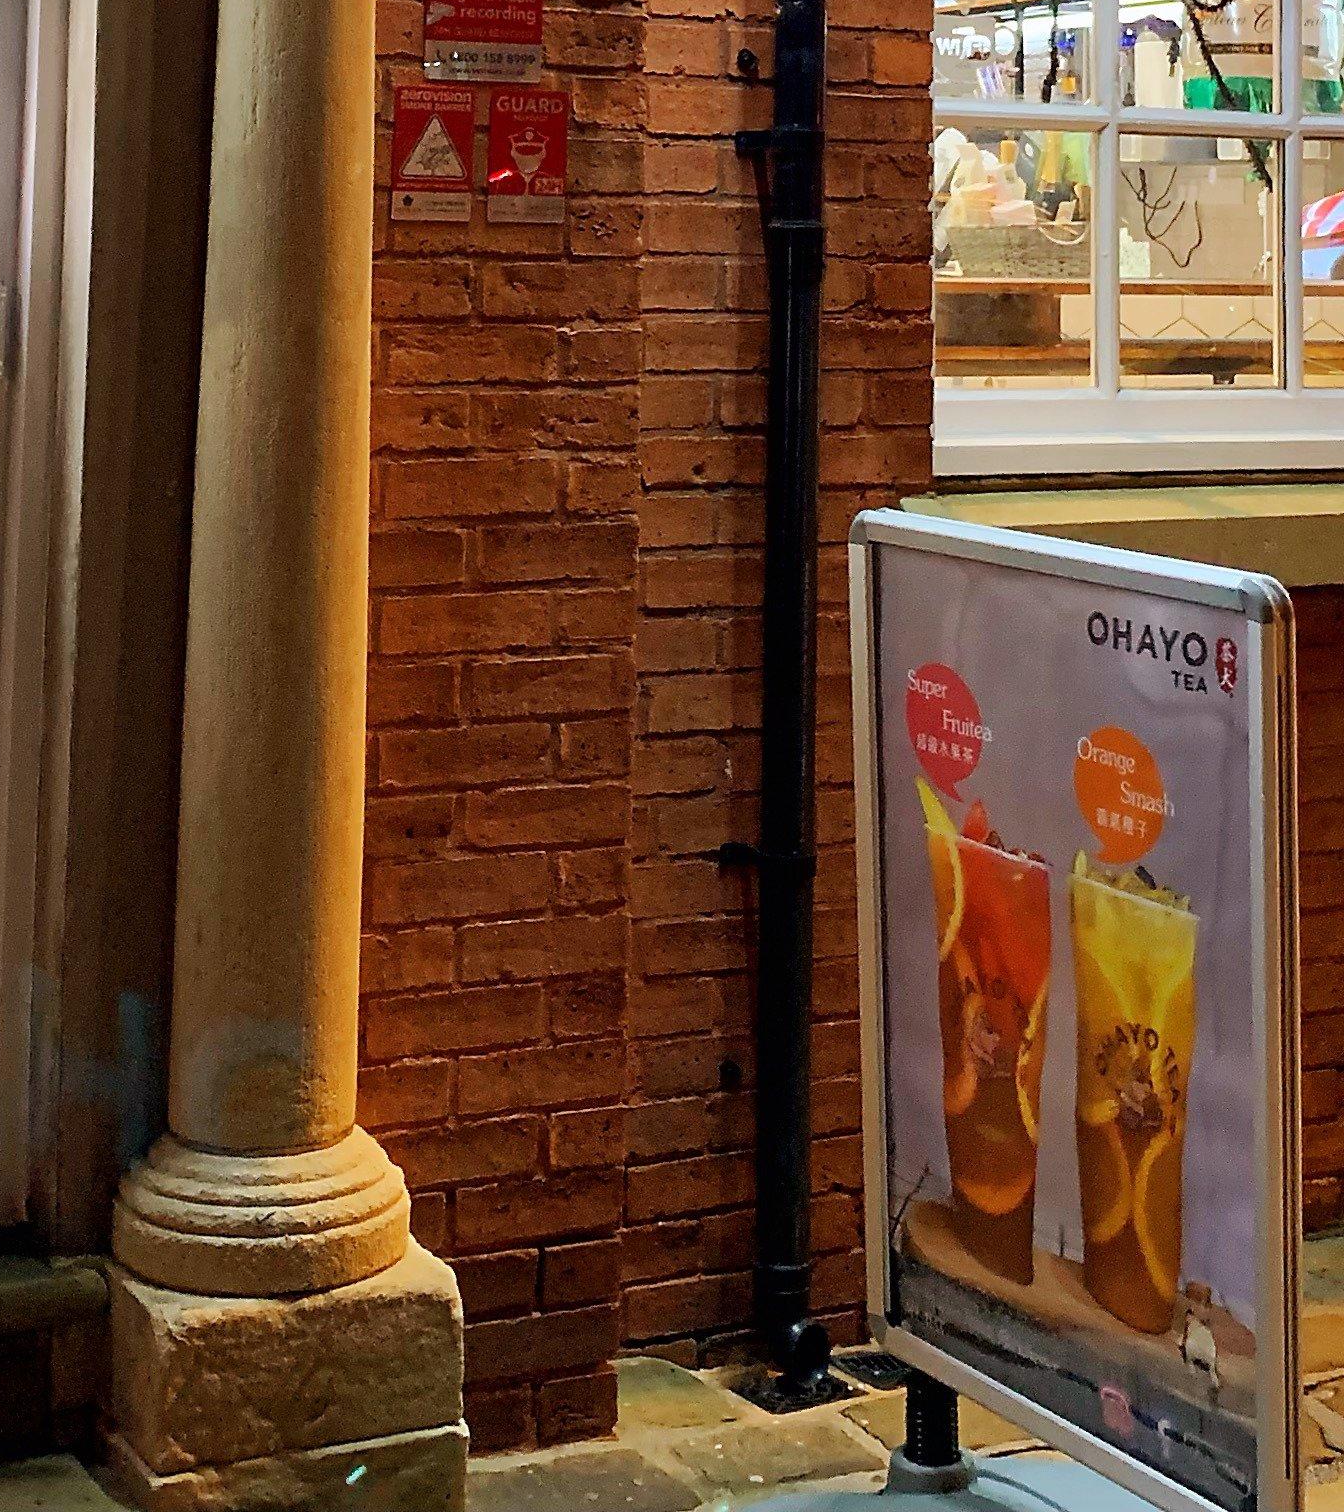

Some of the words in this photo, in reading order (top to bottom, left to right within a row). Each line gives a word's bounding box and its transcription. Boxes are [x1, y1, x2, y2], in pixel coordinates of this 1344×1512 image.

[459, 6, 537, 25] recording
[495, 95, 564, 114] GUARD
[1087, 610, 1208, 667] OHAYO
[906, 668, 948, 700] Super
[1171, 669, 1208, 695] TEA
[941, 708, 993, 743] Fruitea
[1077, 736, 1135, 775] Orange
[1119, 780, 1176, 818] Smash
